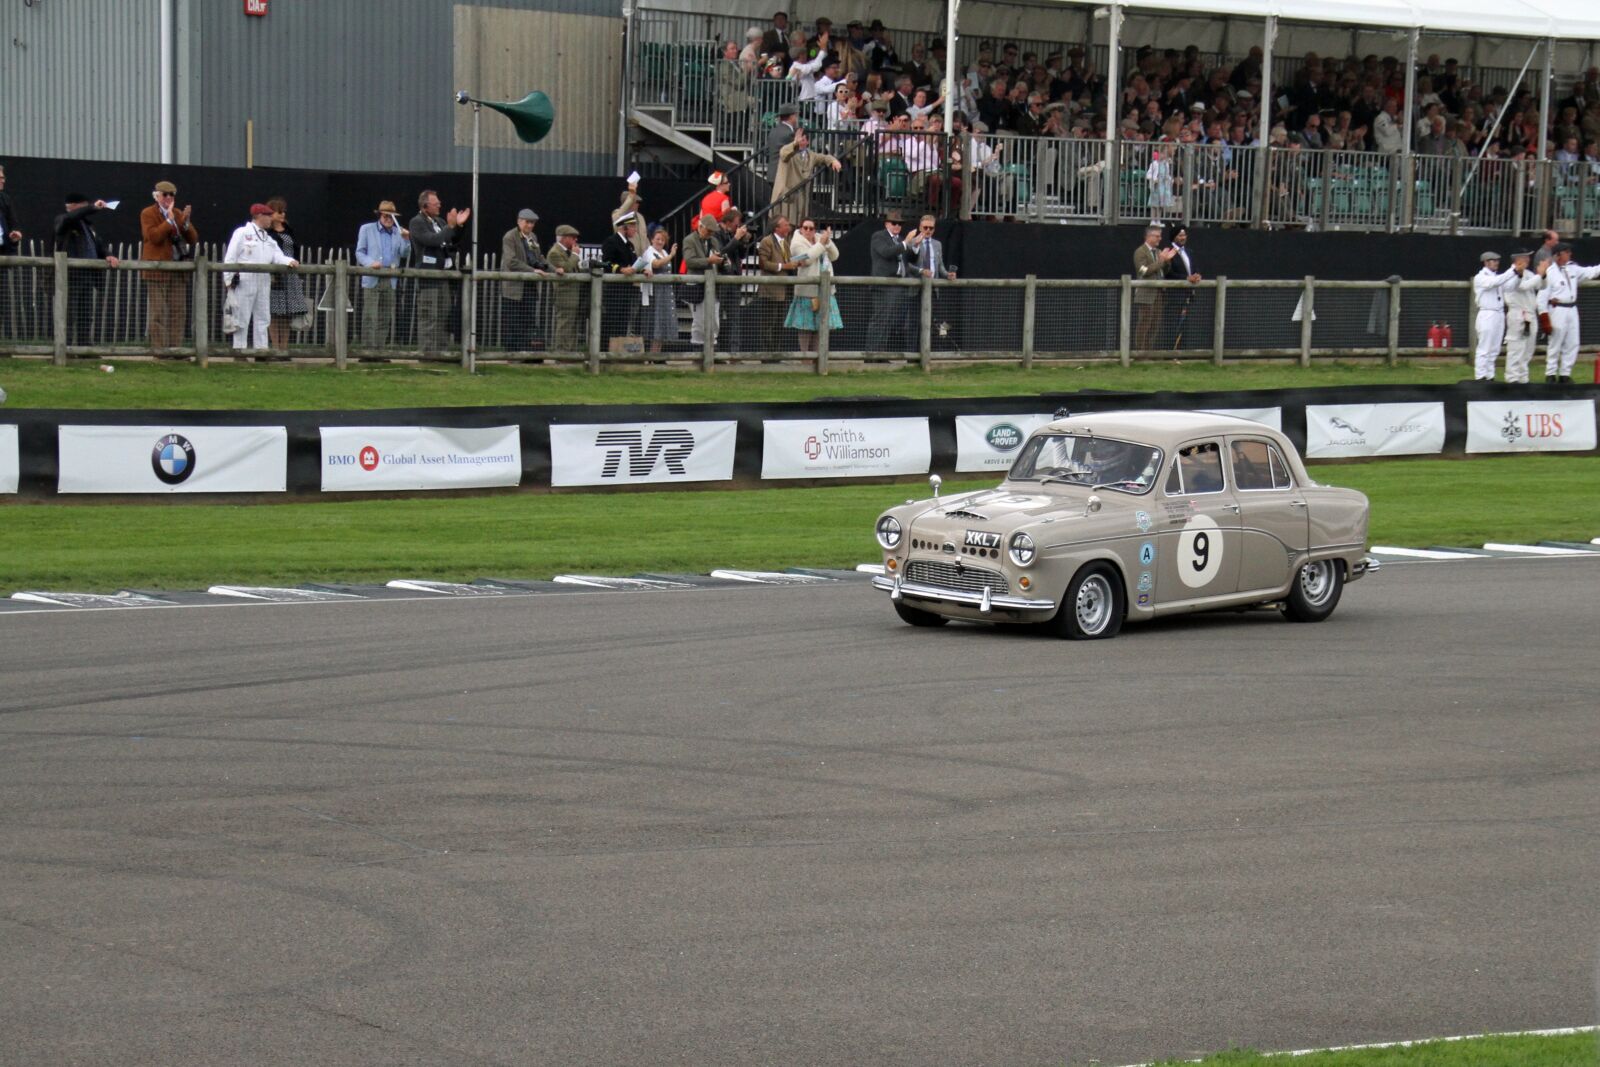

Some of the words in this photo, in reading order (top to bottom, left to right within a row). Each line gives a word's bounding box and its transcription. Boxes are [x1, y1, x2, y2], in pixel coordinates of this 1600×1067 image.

[1525, 413, 1563, 438] UBS
[156, 435, 192, 451] BMW
[822, 428, 857, 443] Smith
[858, 431, 866, 442] &
[1327, 438, 1366, 446] JAGUAR
[328, 454, 355, 466] BMO
[383, 453, 416, 466] Global
[420, 454, 445, 465] Asset
[448, 453, 513, 467] Management
[595, 430, 695, 477] TVR
[825, 445, 890, 460] Williamson
[1143, 547, 1151, 561] A
[1192, 531, 1209, 572] 9
